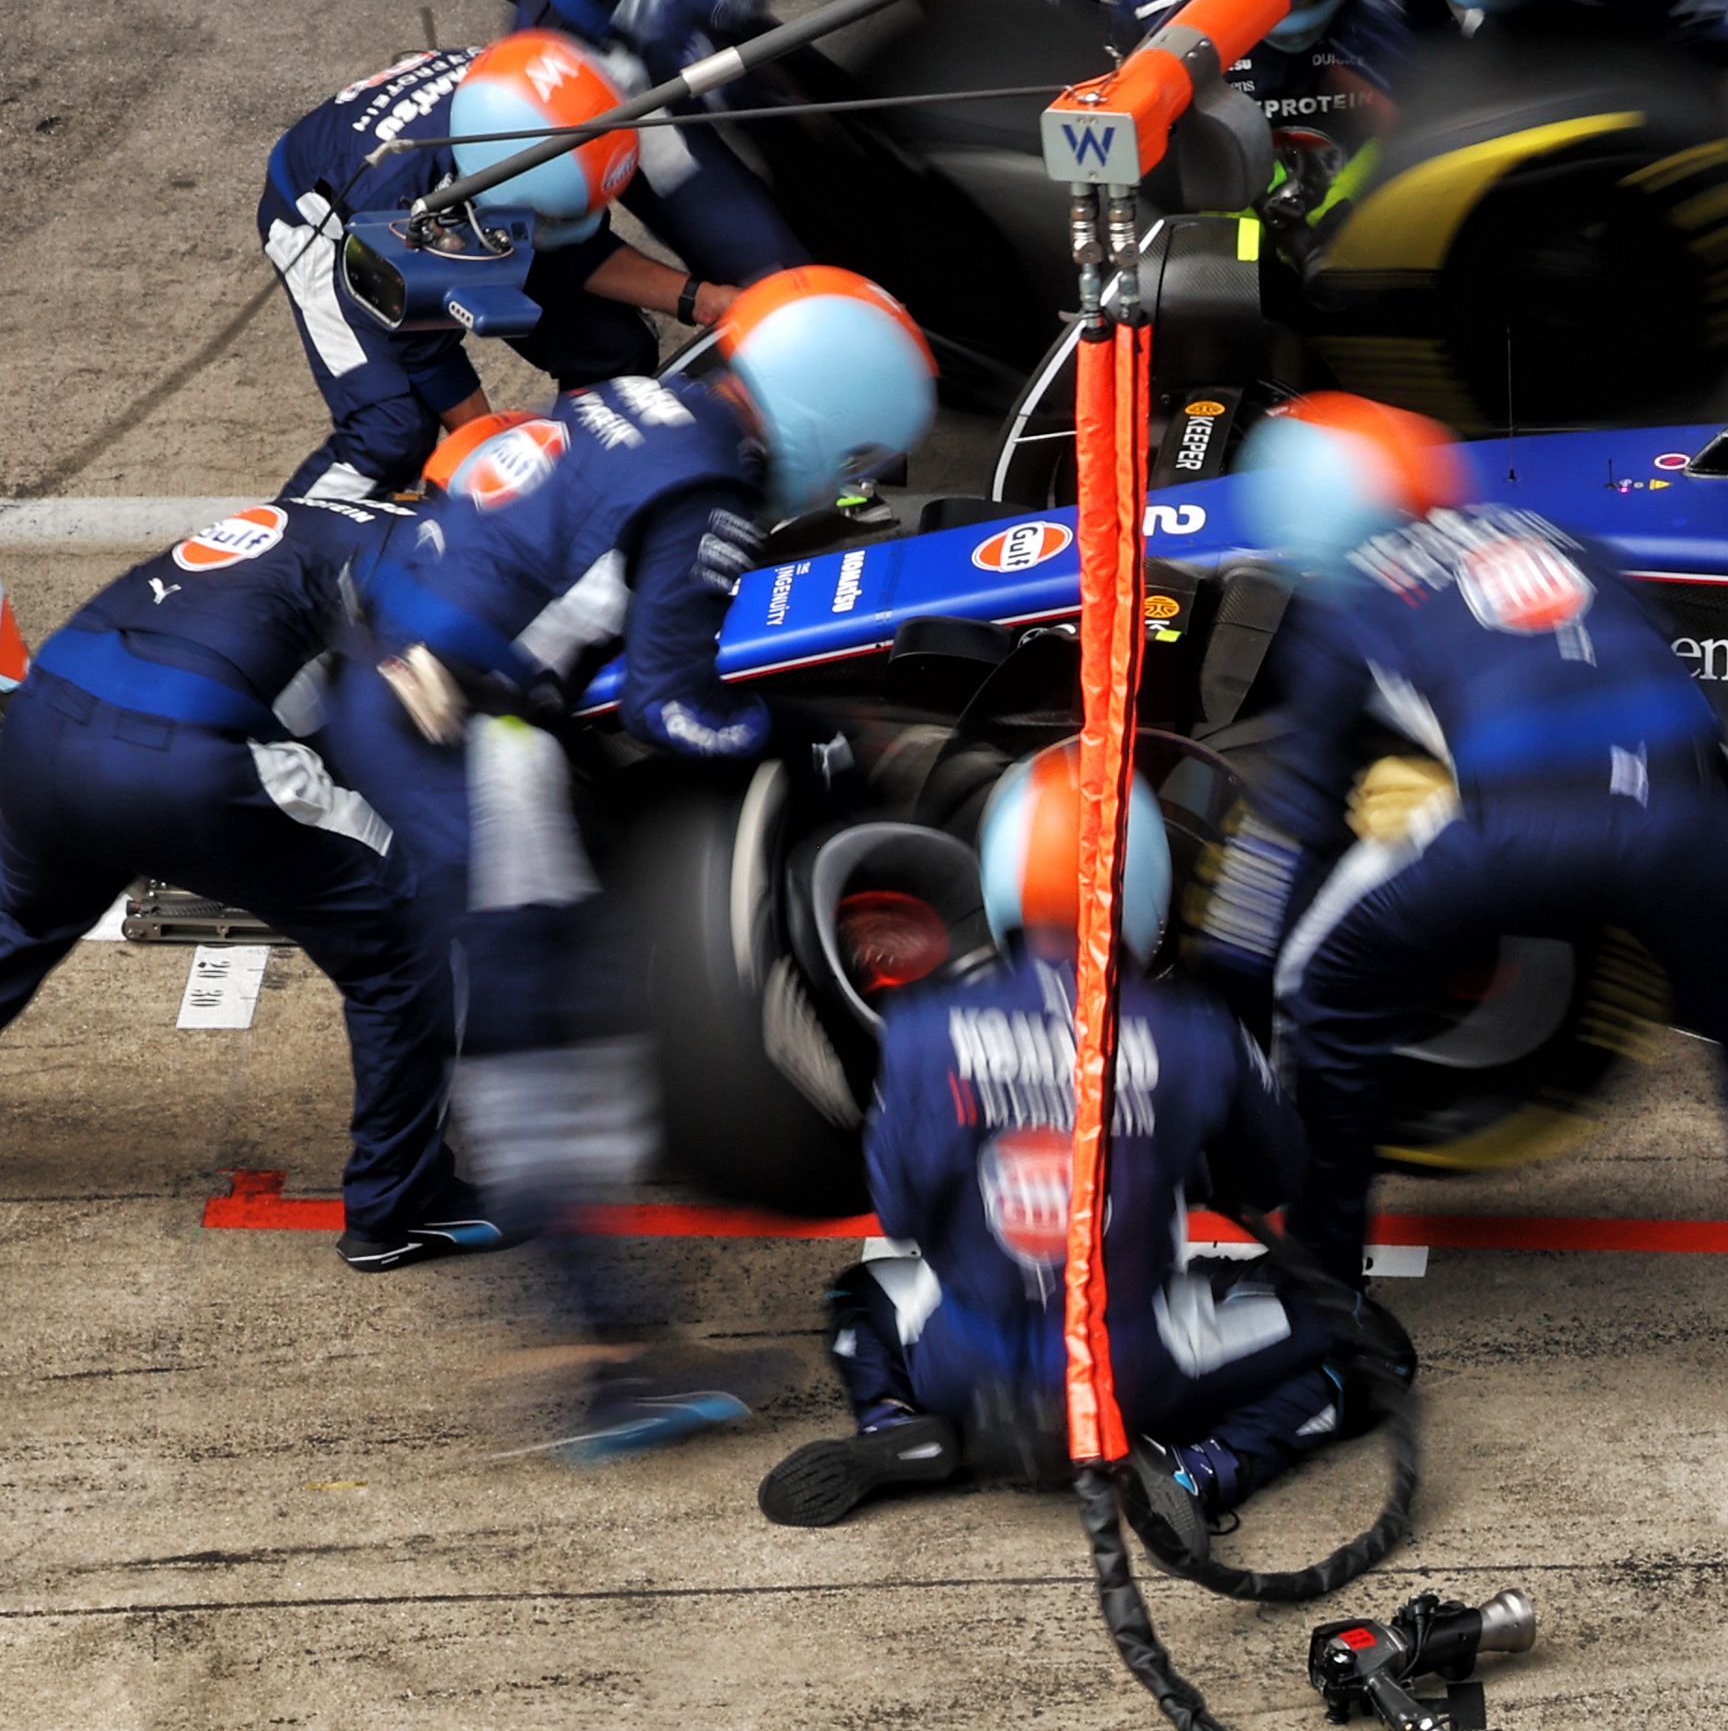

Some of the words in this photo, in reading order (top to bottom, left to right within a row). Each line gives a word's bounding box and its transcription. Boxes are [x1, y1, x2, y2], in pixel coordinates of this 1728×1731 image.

[1062, 124, 1116, 167] W
[1175, 416, 1215, 470] KEEPER
[1143, 504, 1207, 536] 2
[1004, 526, 1040, 570] Gulf
[832, 549, 866, 613] KOMATSU
